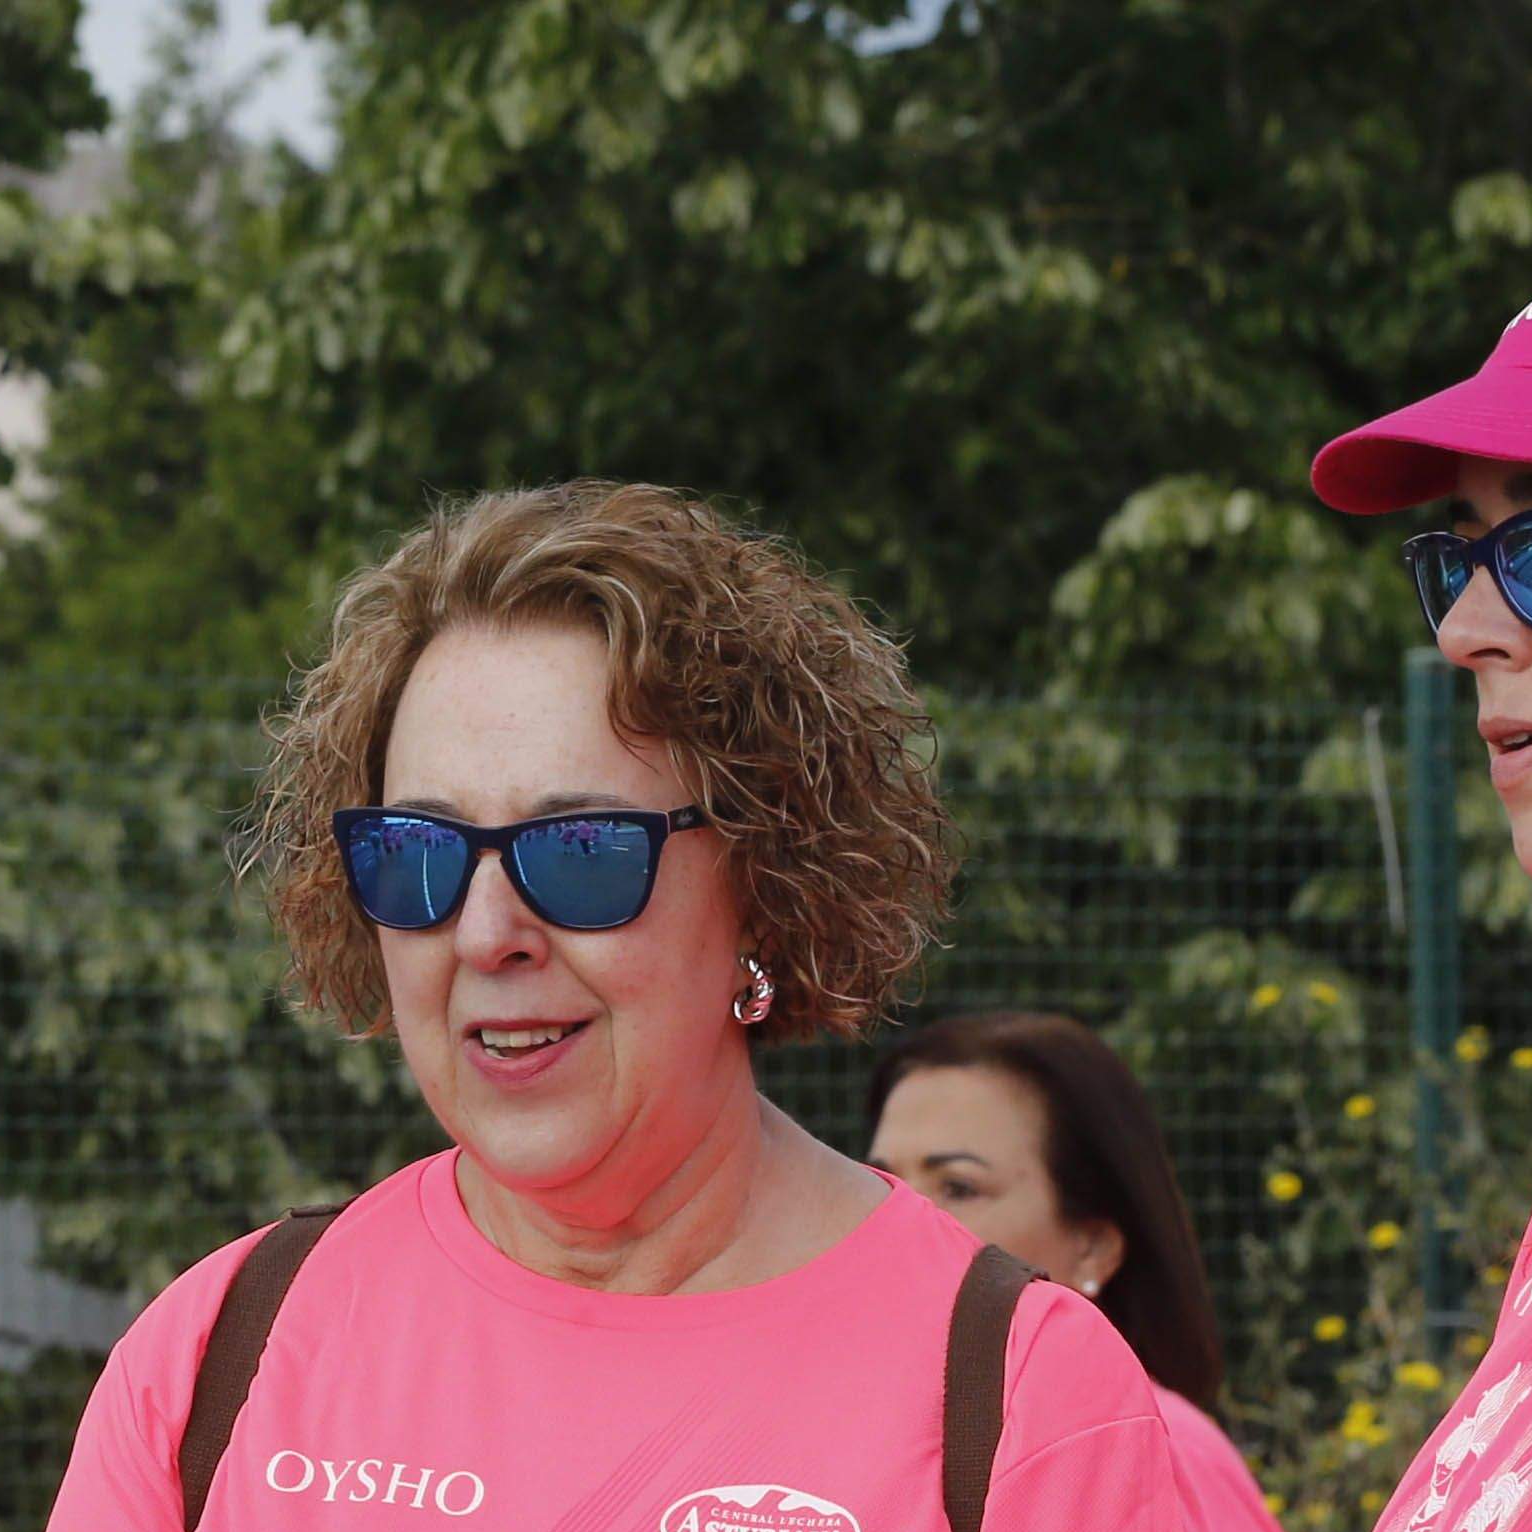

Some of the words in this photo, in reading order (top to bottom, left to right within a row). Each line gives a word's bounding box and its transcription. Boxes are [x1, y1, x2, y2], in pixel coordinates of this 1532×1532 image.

[265, 1449, 486, 1517] OYSHO
[710, 1507, 774, 1525] CENTRAL
[779, 1517, 842, 1527] LECHERA
